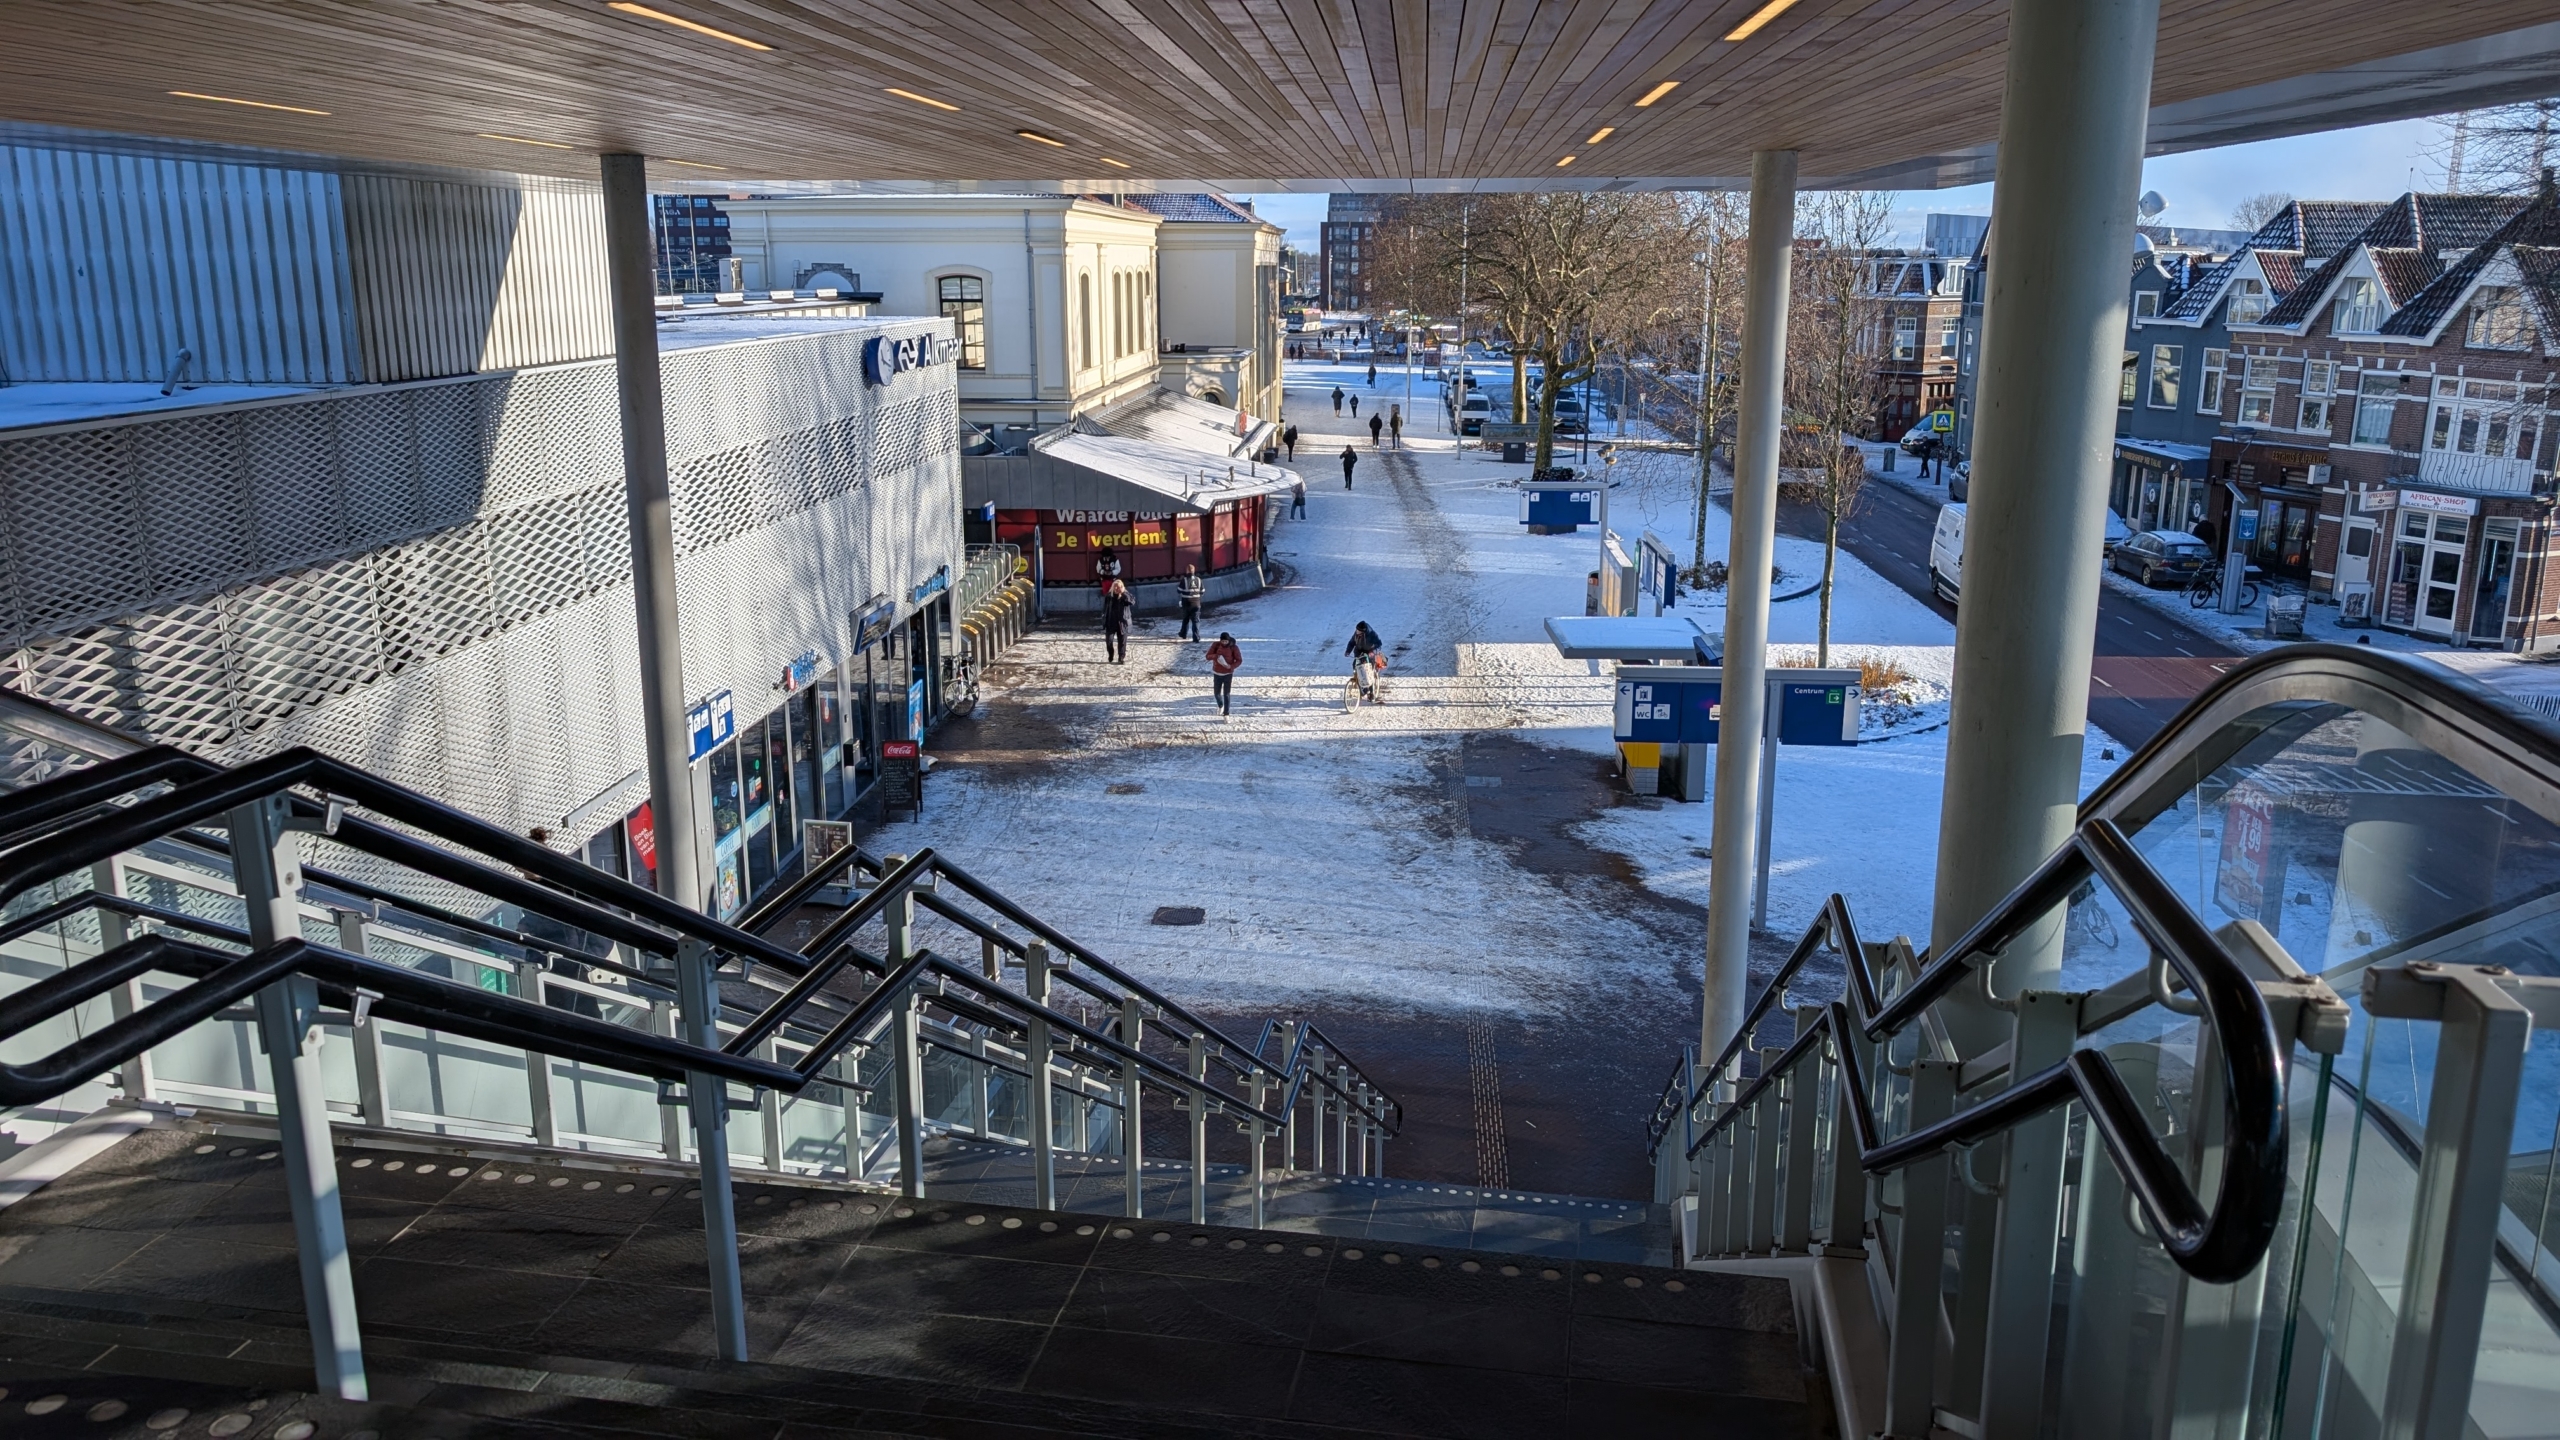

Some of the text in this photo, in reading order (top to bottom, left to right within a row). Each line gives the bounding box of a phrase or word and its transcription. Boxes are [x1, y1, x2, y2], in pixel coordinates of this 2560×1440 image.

[924, 333, 963, 367] Alkmaar
[1056, 532, 1078, 547] Je
[1091, 529, 1167, 547] verdient
[634, 827, 648, 841] Boek
[720, 835, 735, 857] COFFEE
